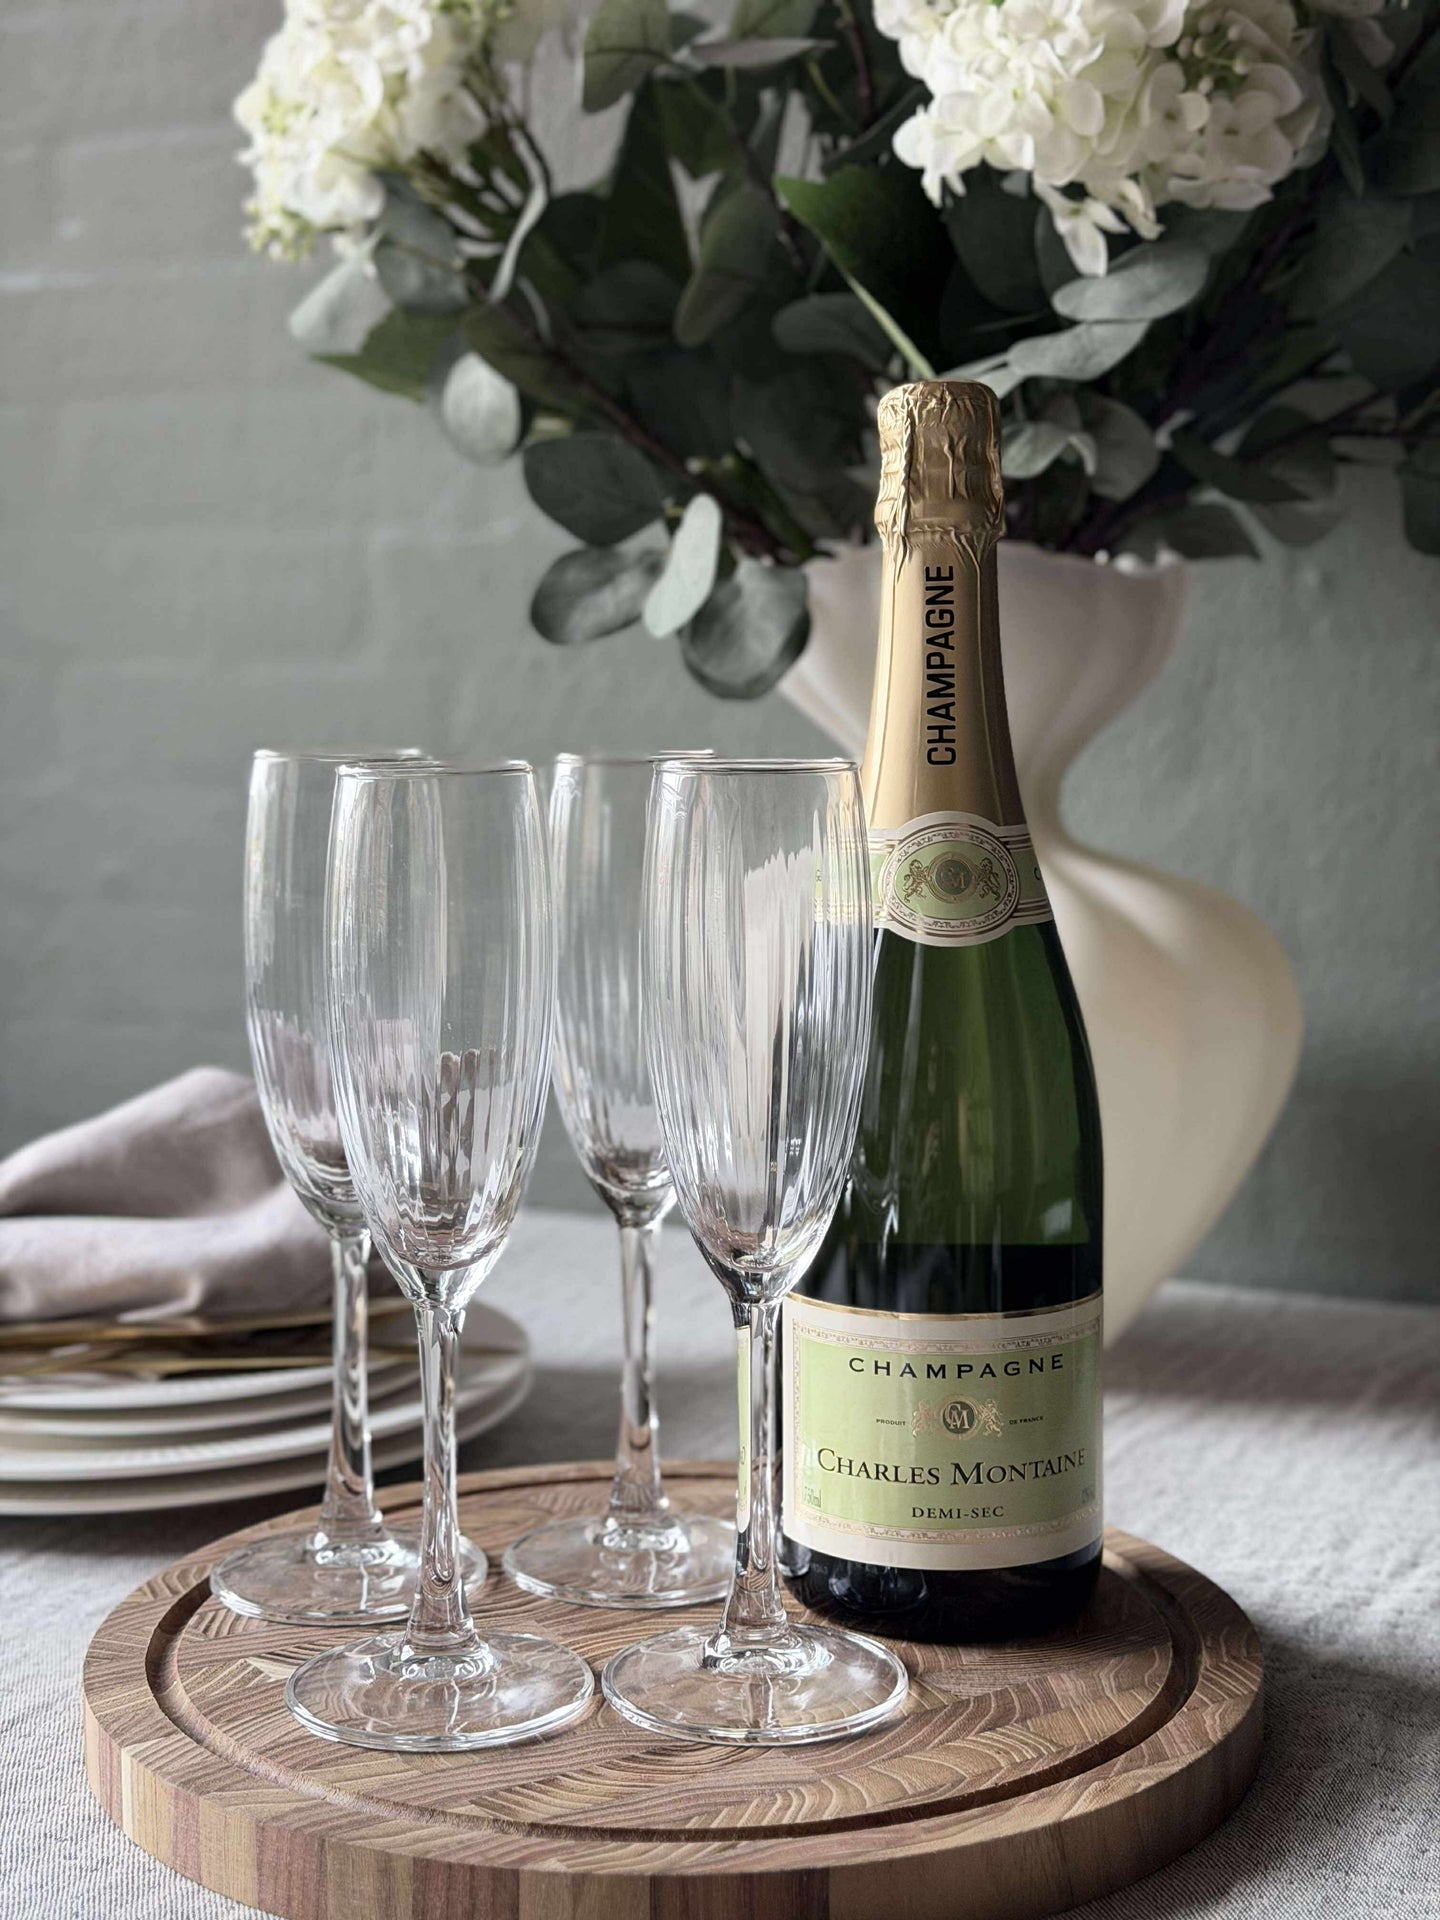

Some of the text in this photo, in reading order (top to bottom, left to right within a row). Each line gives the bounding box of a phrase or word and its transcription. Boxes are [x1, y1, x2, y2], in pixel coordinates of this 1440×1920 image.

[925, 565, 956, 766] CHAMPAGNE
[848, 1353, 1064, 1380] CHAMPAGNE
[876, 1418, 906, 1426] PRODUIT
[1019, 1416, 1044, 1424] FRANCE
[817, 1447, 1086, 1487] CHARLES MONTAINE
[911, 1506, 1005, 1520] DEMI-SEC
